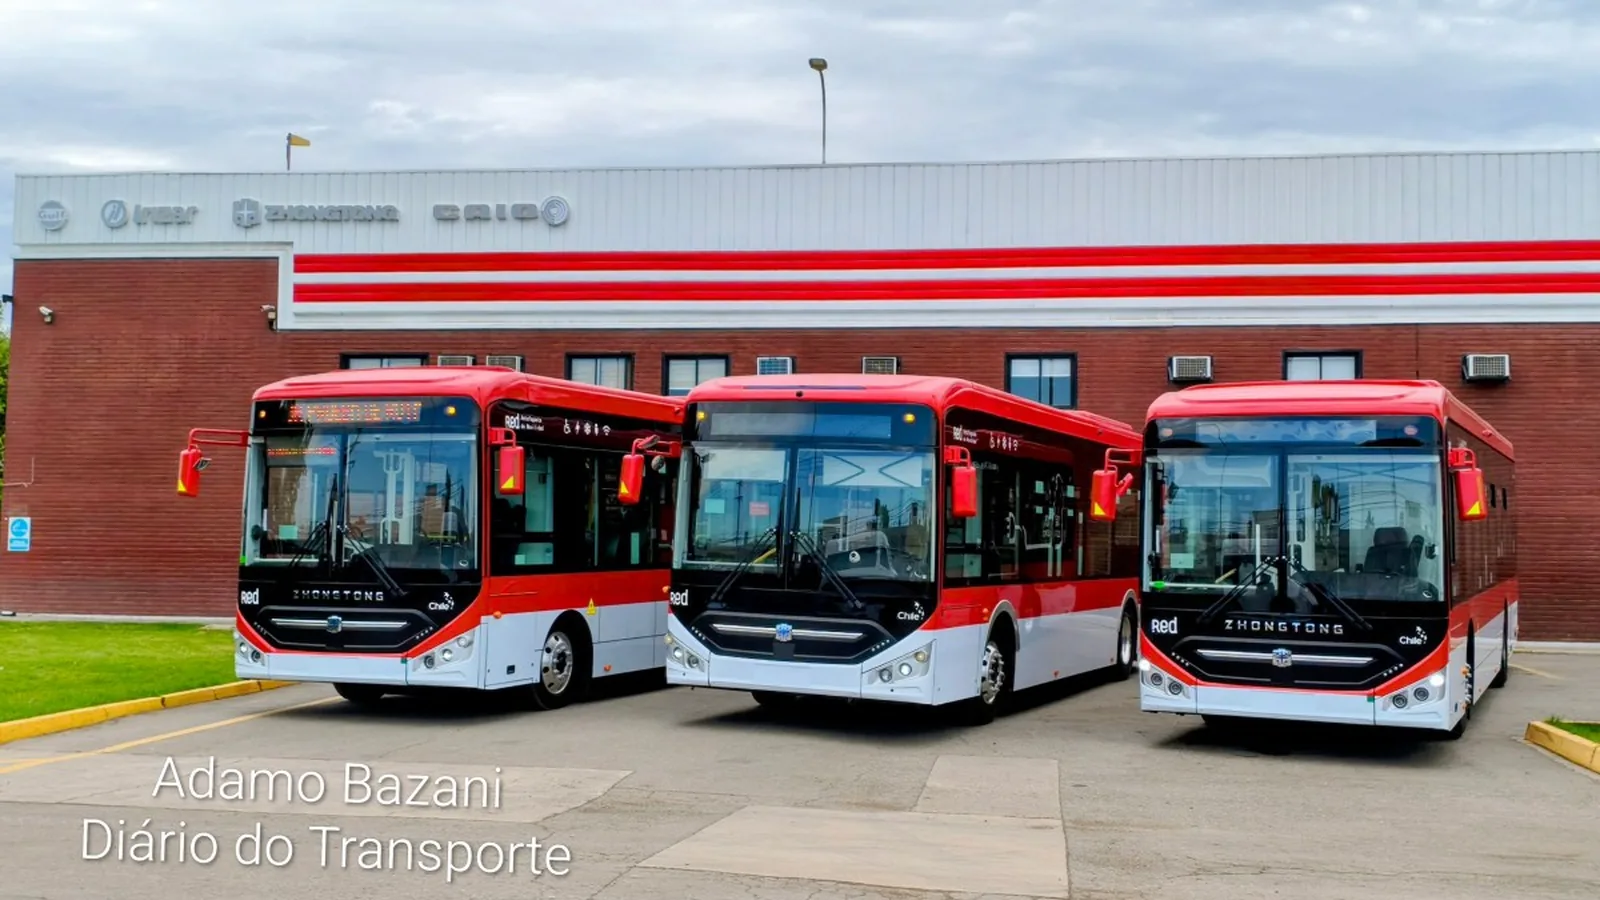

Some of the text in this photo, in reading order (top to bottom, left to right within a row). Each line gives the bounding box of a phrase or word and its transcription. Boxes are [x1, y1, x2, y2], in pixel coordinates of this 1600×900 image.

[505, 413, 520, 430] Red
[241, 589, 259, 605] Red
[293, 590, 384, 601] ZHONGTONG
[429, 602, 449, 611] Chile
[897, 611, 920, 621] Chile
[1151, 616, 1178, 634] Red
[1224, 619, 1344, 635] ZHONGTONG
[1399, 635, 1422, 645] Chile
